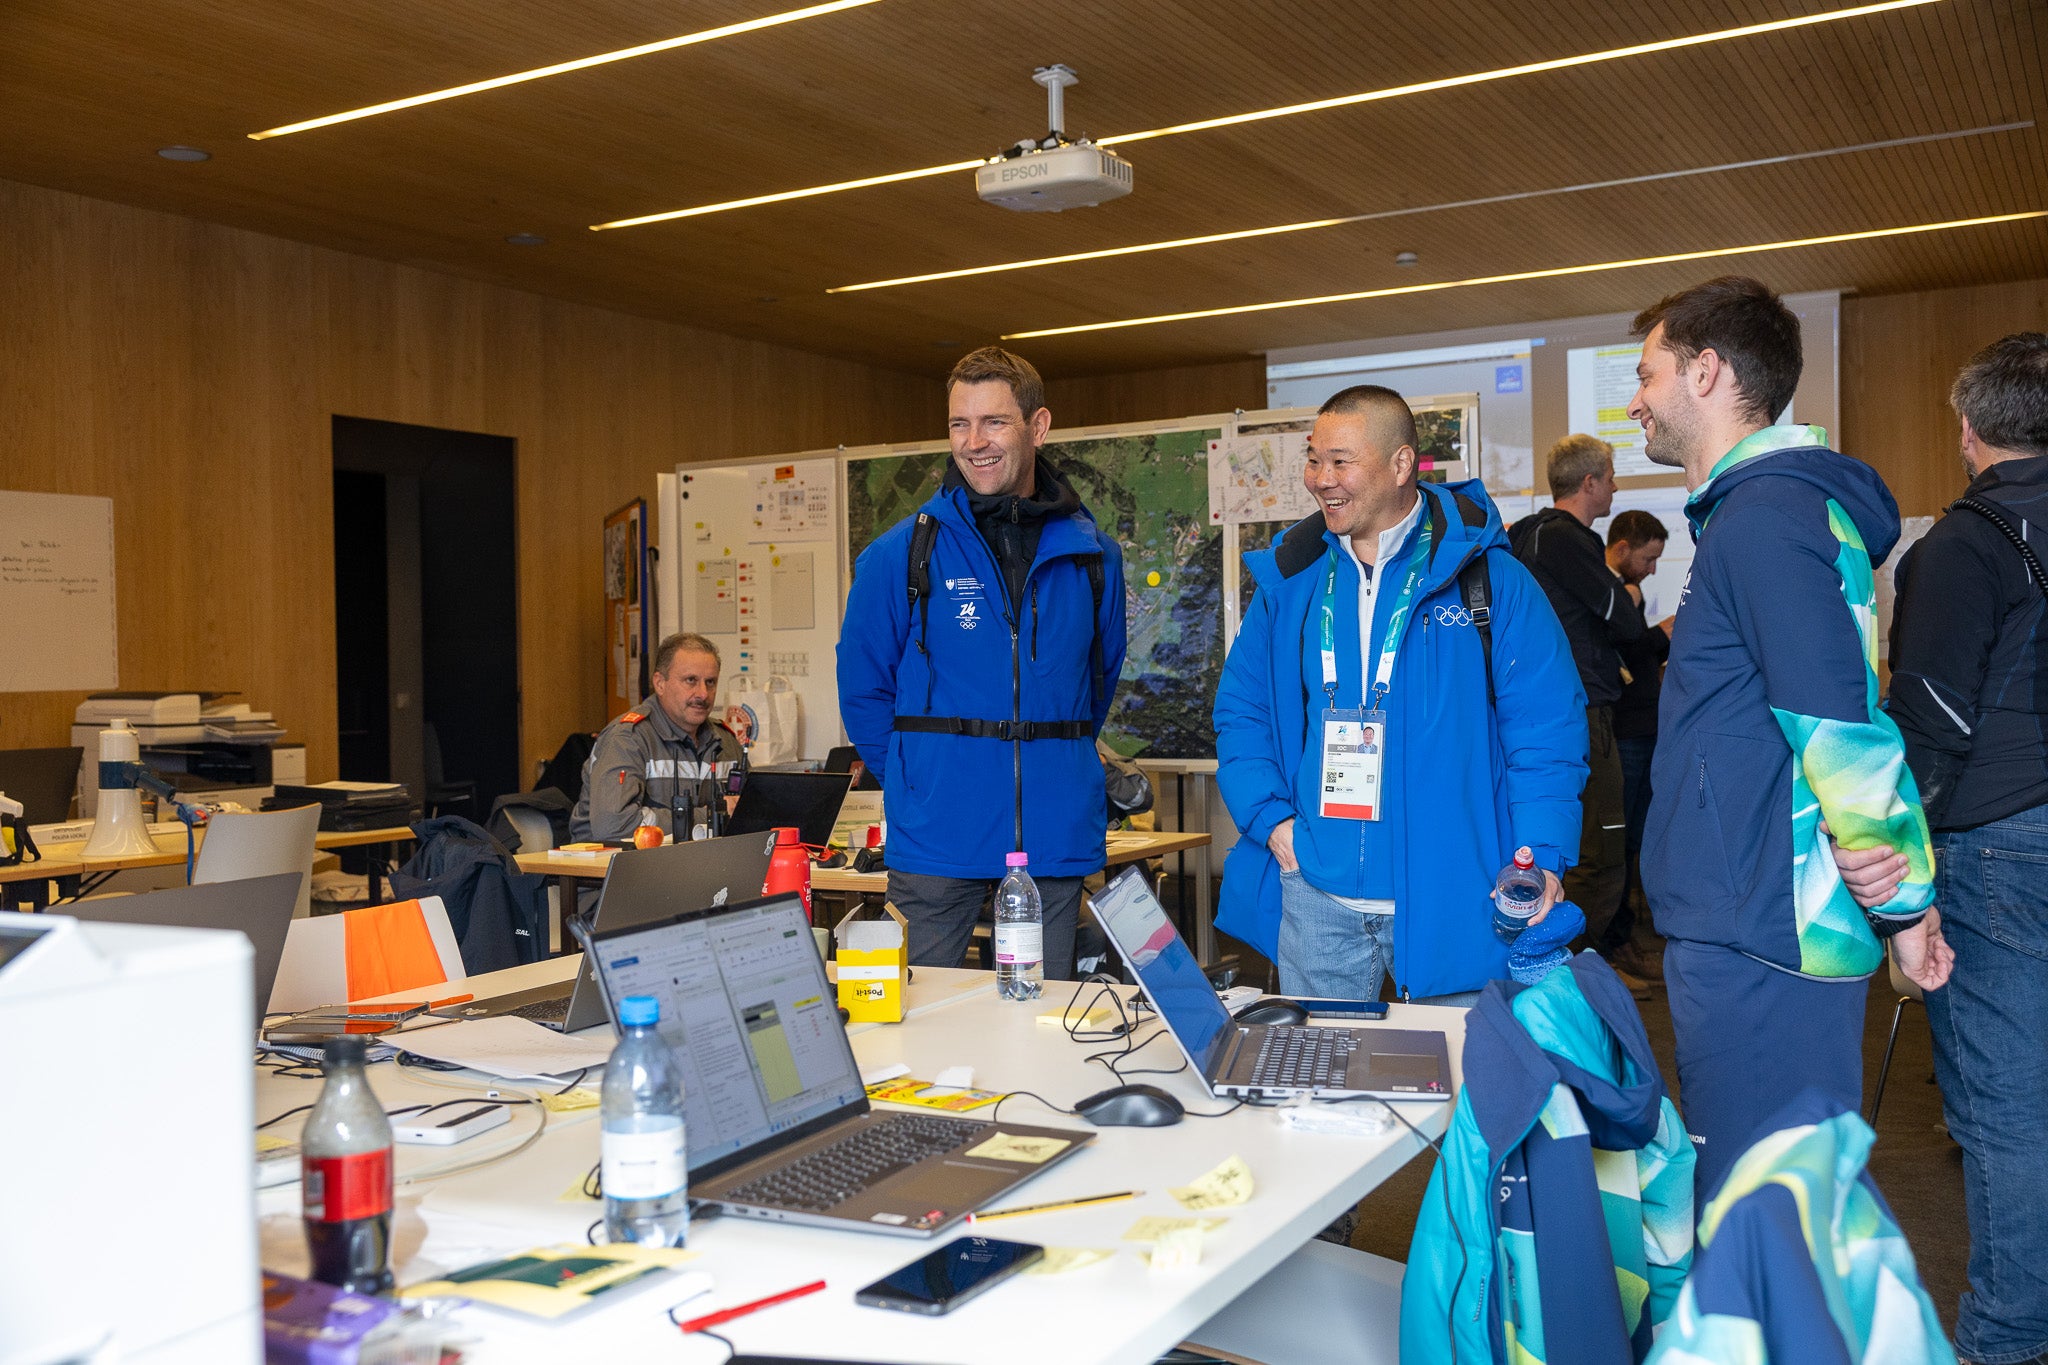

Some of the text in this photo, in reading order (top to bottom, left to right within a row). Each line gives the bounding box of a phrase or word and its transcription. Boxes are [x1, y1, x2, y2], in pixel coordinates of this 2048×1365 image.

[1002, 163, 1048, 182] EPSON
[1504, 901, 1527, 910] evian
[515, 928, 530, 936] SAL
[856, 989, 883, 997] Post-it
